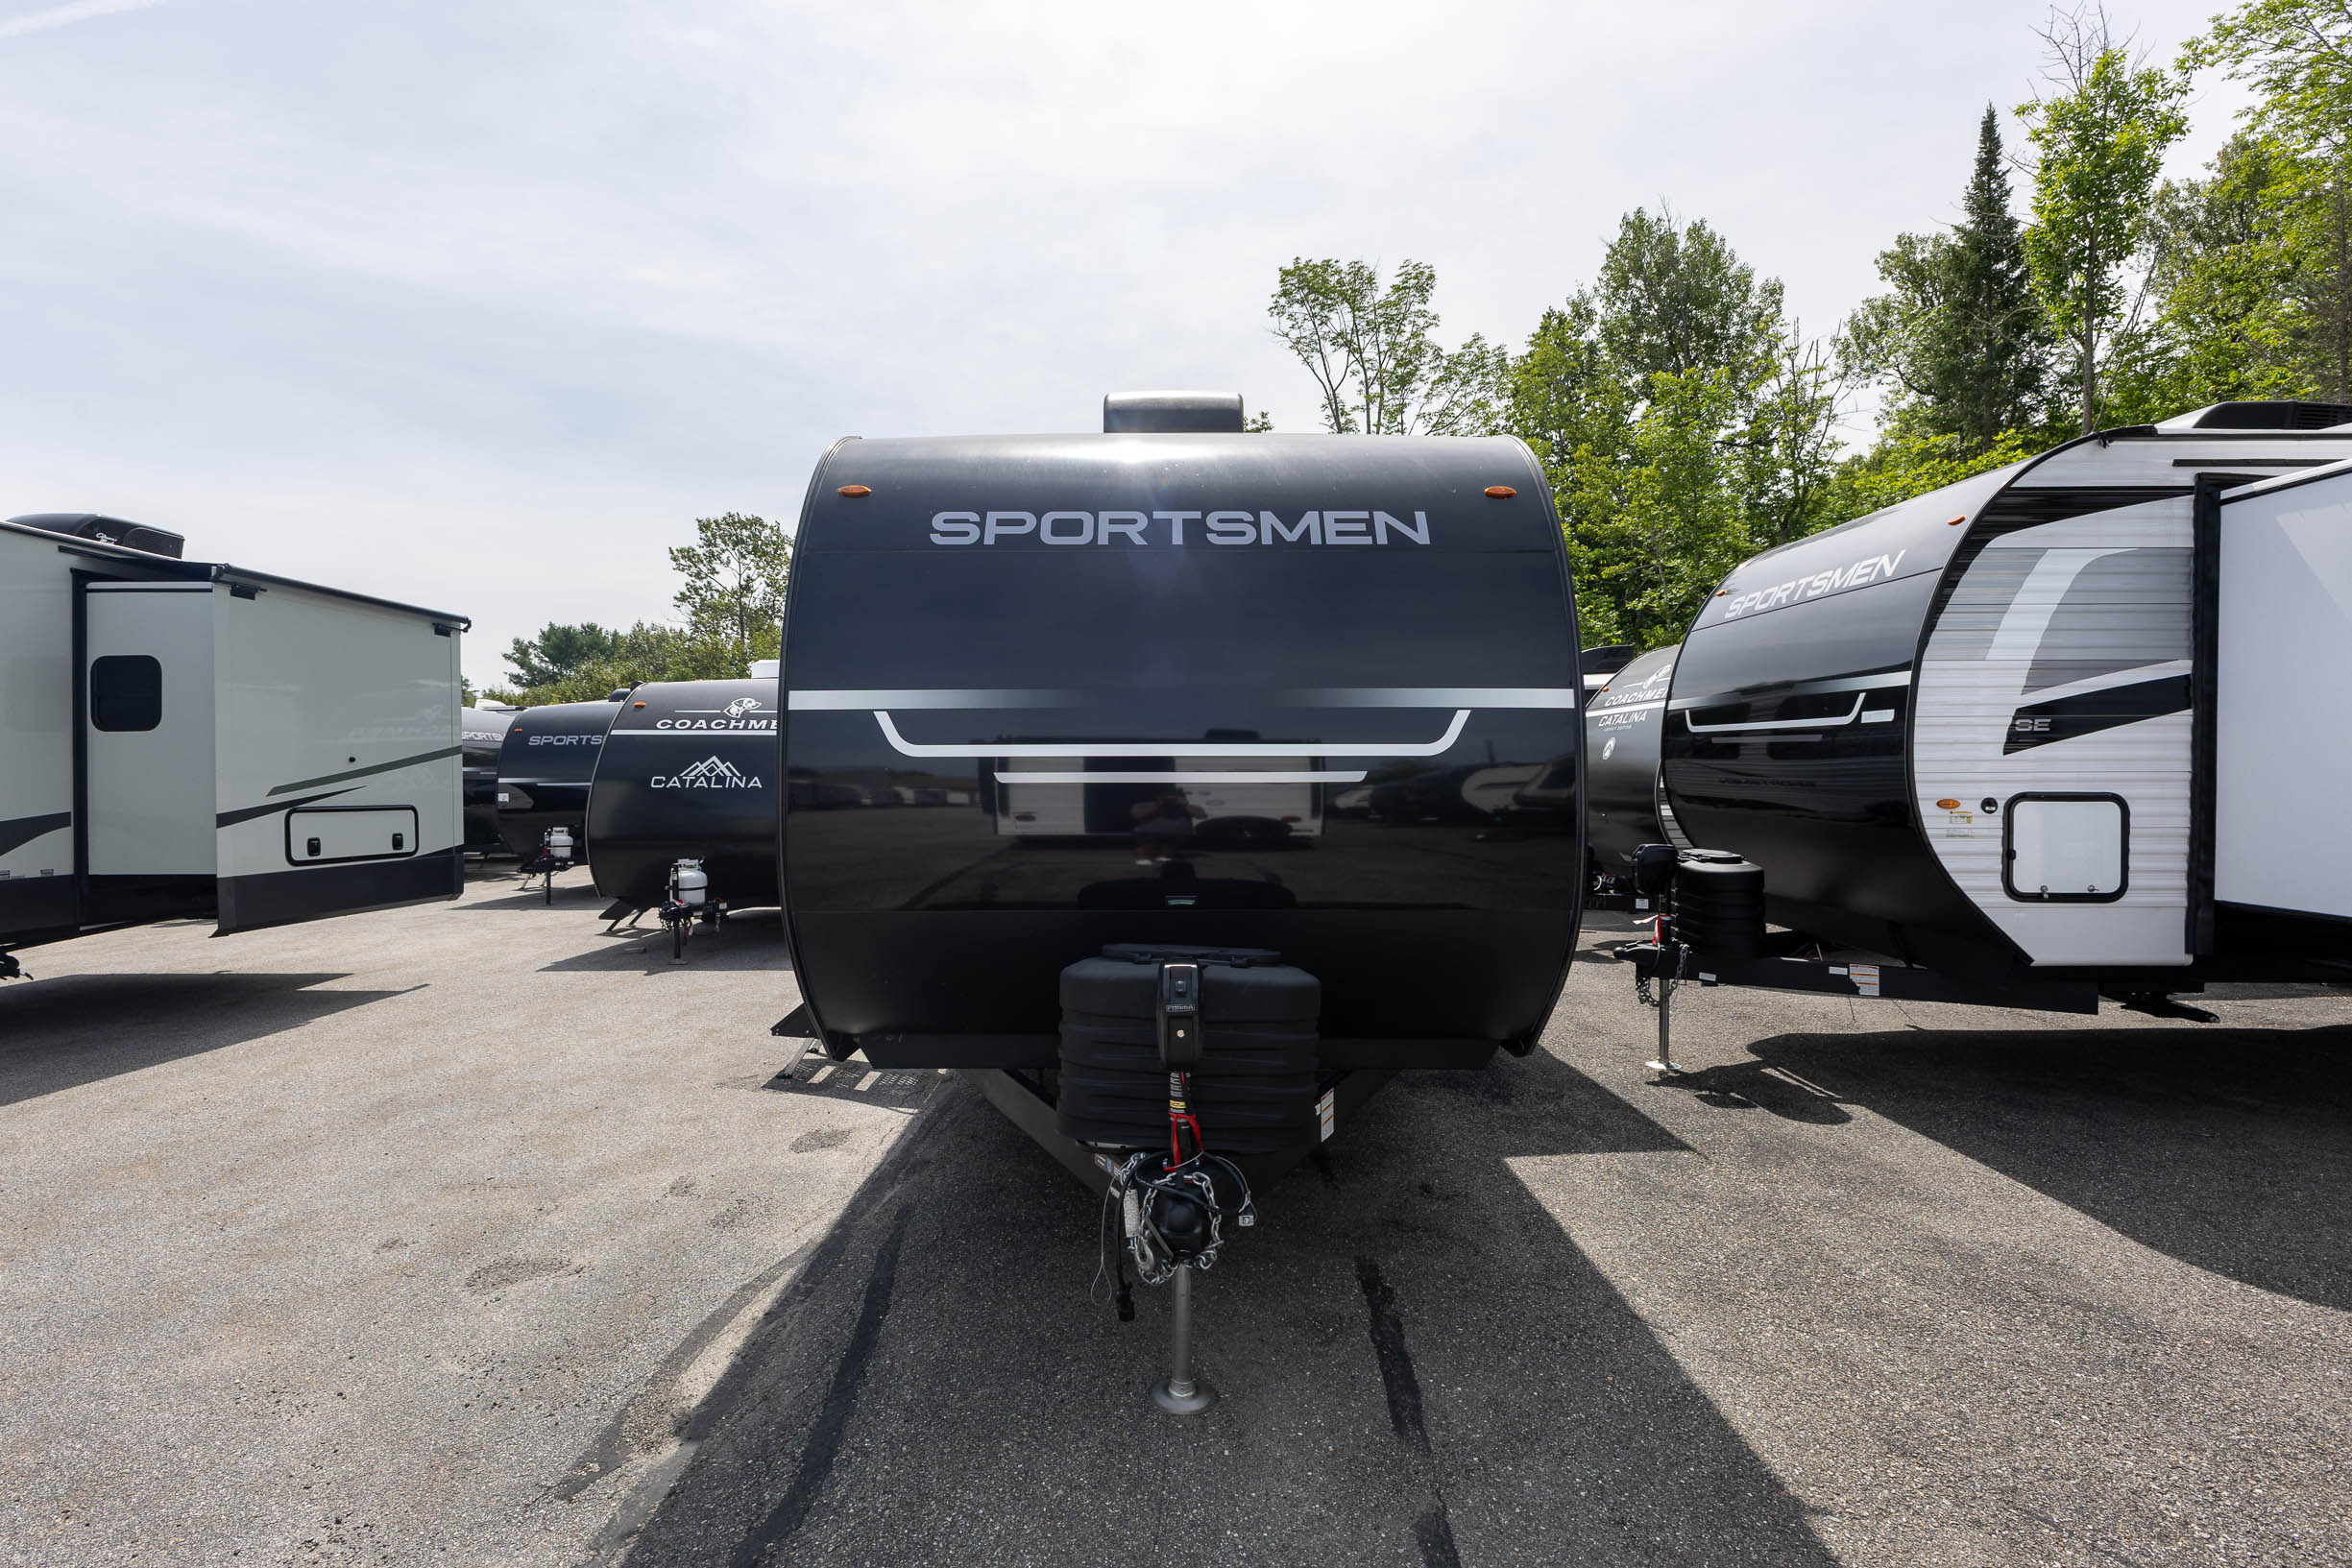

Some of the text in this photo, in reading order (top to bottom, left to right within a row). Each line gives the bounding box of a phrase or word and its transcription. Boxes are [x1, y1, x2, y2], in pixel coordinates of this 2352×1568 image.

[930, 511, 1431, 545] SPORTSMEN
[1724, 549, 1906, 619] SPORTSMEN
[1598, 711, 1647, 727] CATALINA
[2015, 718, 2051, 732] SE
[650, 776, 763, 788] CATALINA
